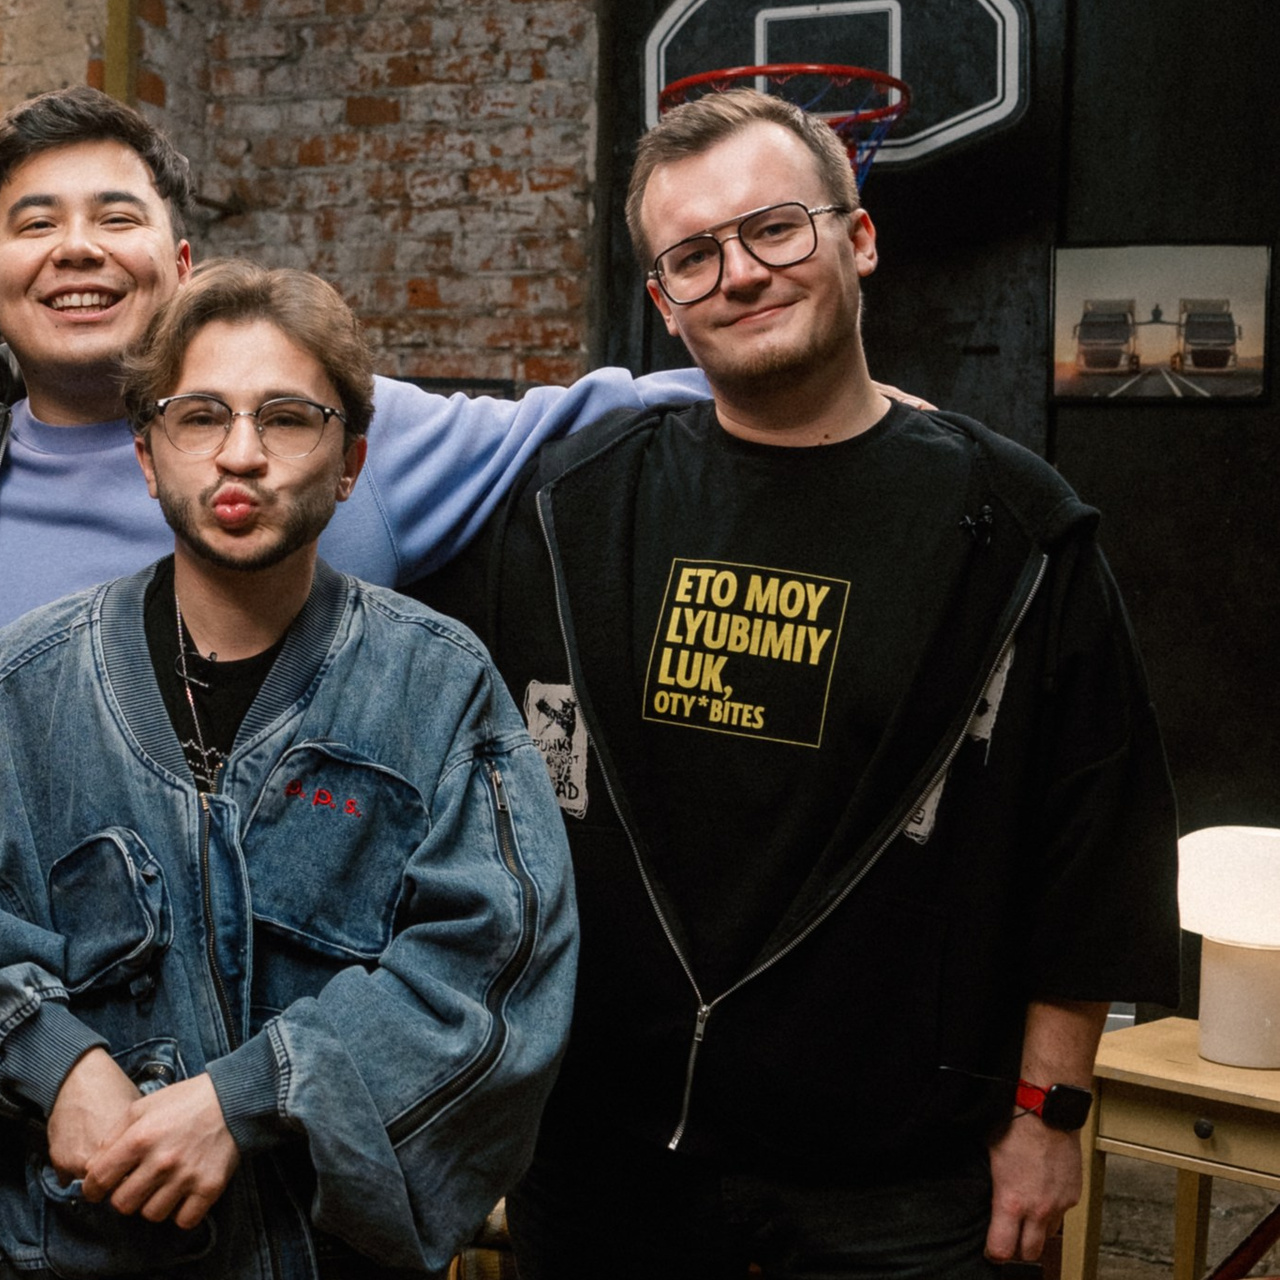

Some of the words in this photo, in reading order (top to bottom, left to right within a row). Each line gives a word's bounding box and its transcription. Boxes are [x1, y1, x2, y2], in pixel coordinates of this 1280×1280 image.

[675, 567, 738, 608] ETO
[744, 574, 831, 621] MOY
[666, 607, 832, 665] LYUBIMIY
[658, 647, 733, 701] LUK,
